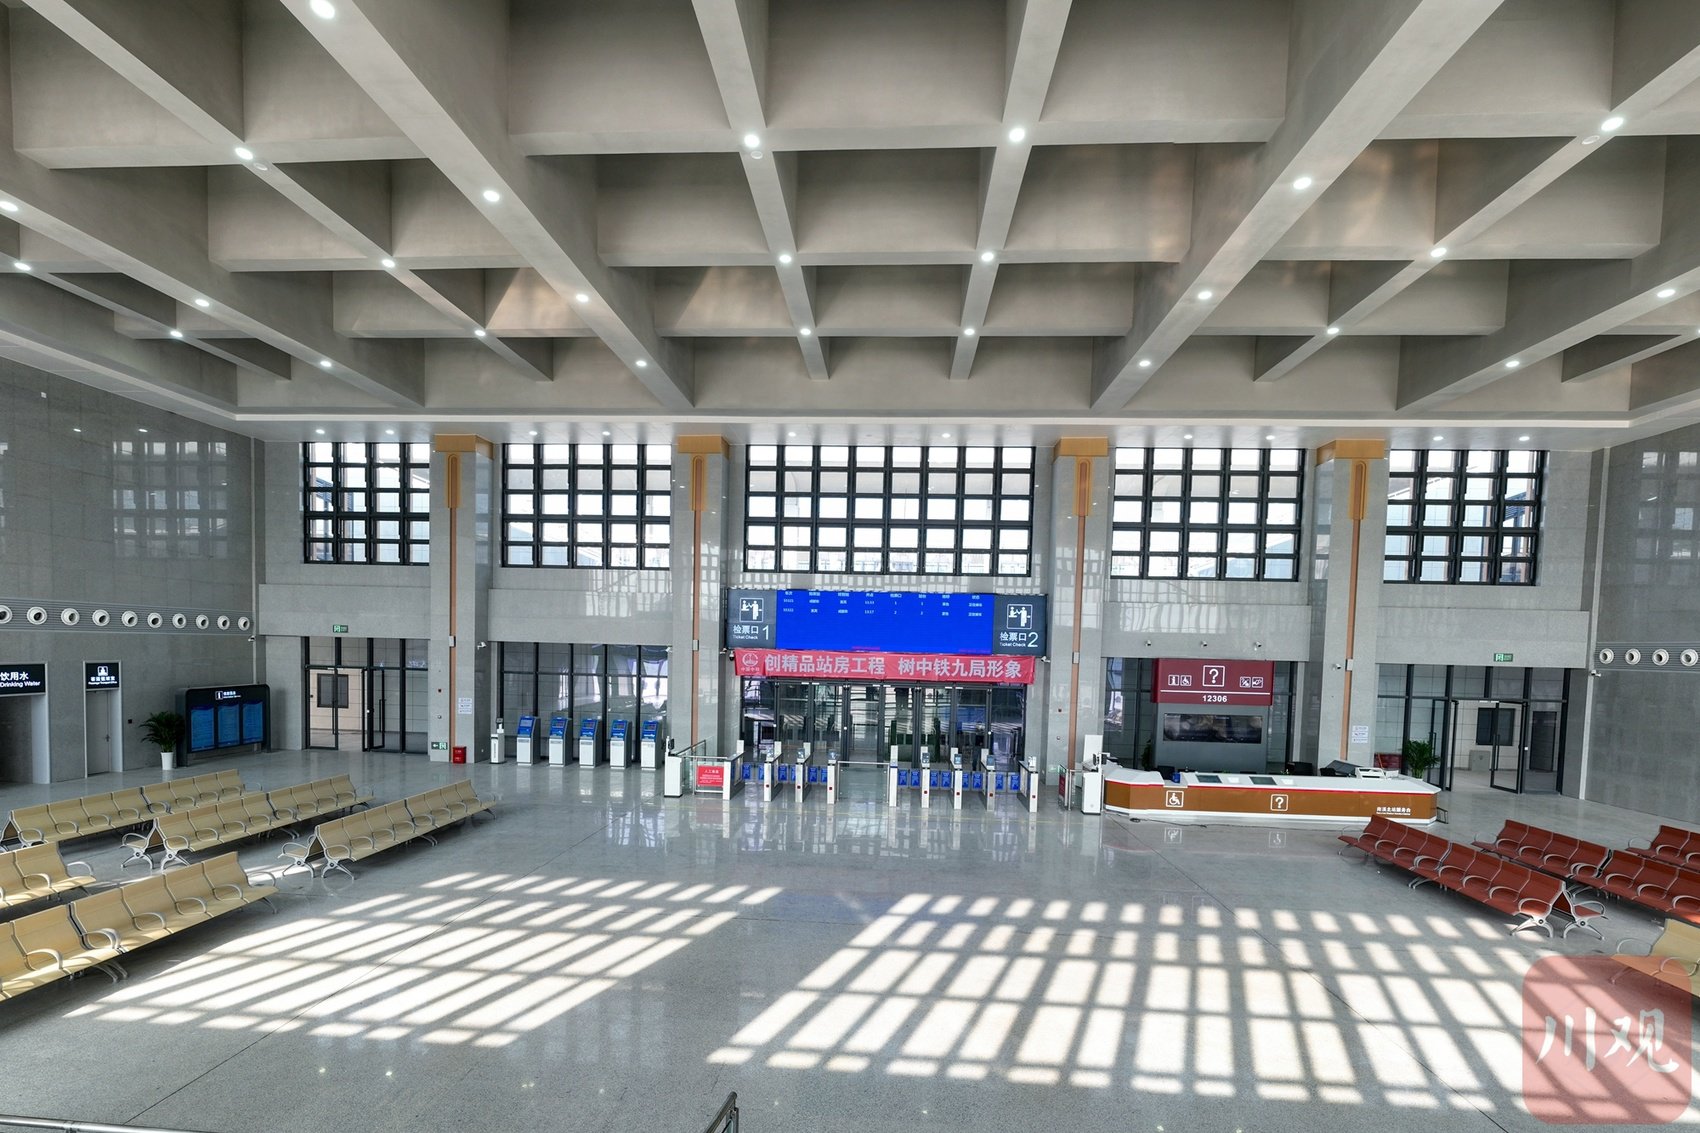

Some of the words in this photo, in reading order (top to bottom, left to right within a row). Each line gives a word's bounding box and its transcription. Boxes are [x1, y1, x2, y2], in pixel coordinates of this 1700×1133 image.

[732, 624, 759, 634] 检票口
[762, 624, 769, 640] 1
[1000, 631, 1027, 641] 检票口
[1027, 631, 1038, 647] 2
[764, 653, 886, 675] 创精品站房工程
[898, 657, 1022, 679] 树中铁九局形象
[0, 672, 29, 681] 饮用水
[1202, 694, 1228, 703] 12306
